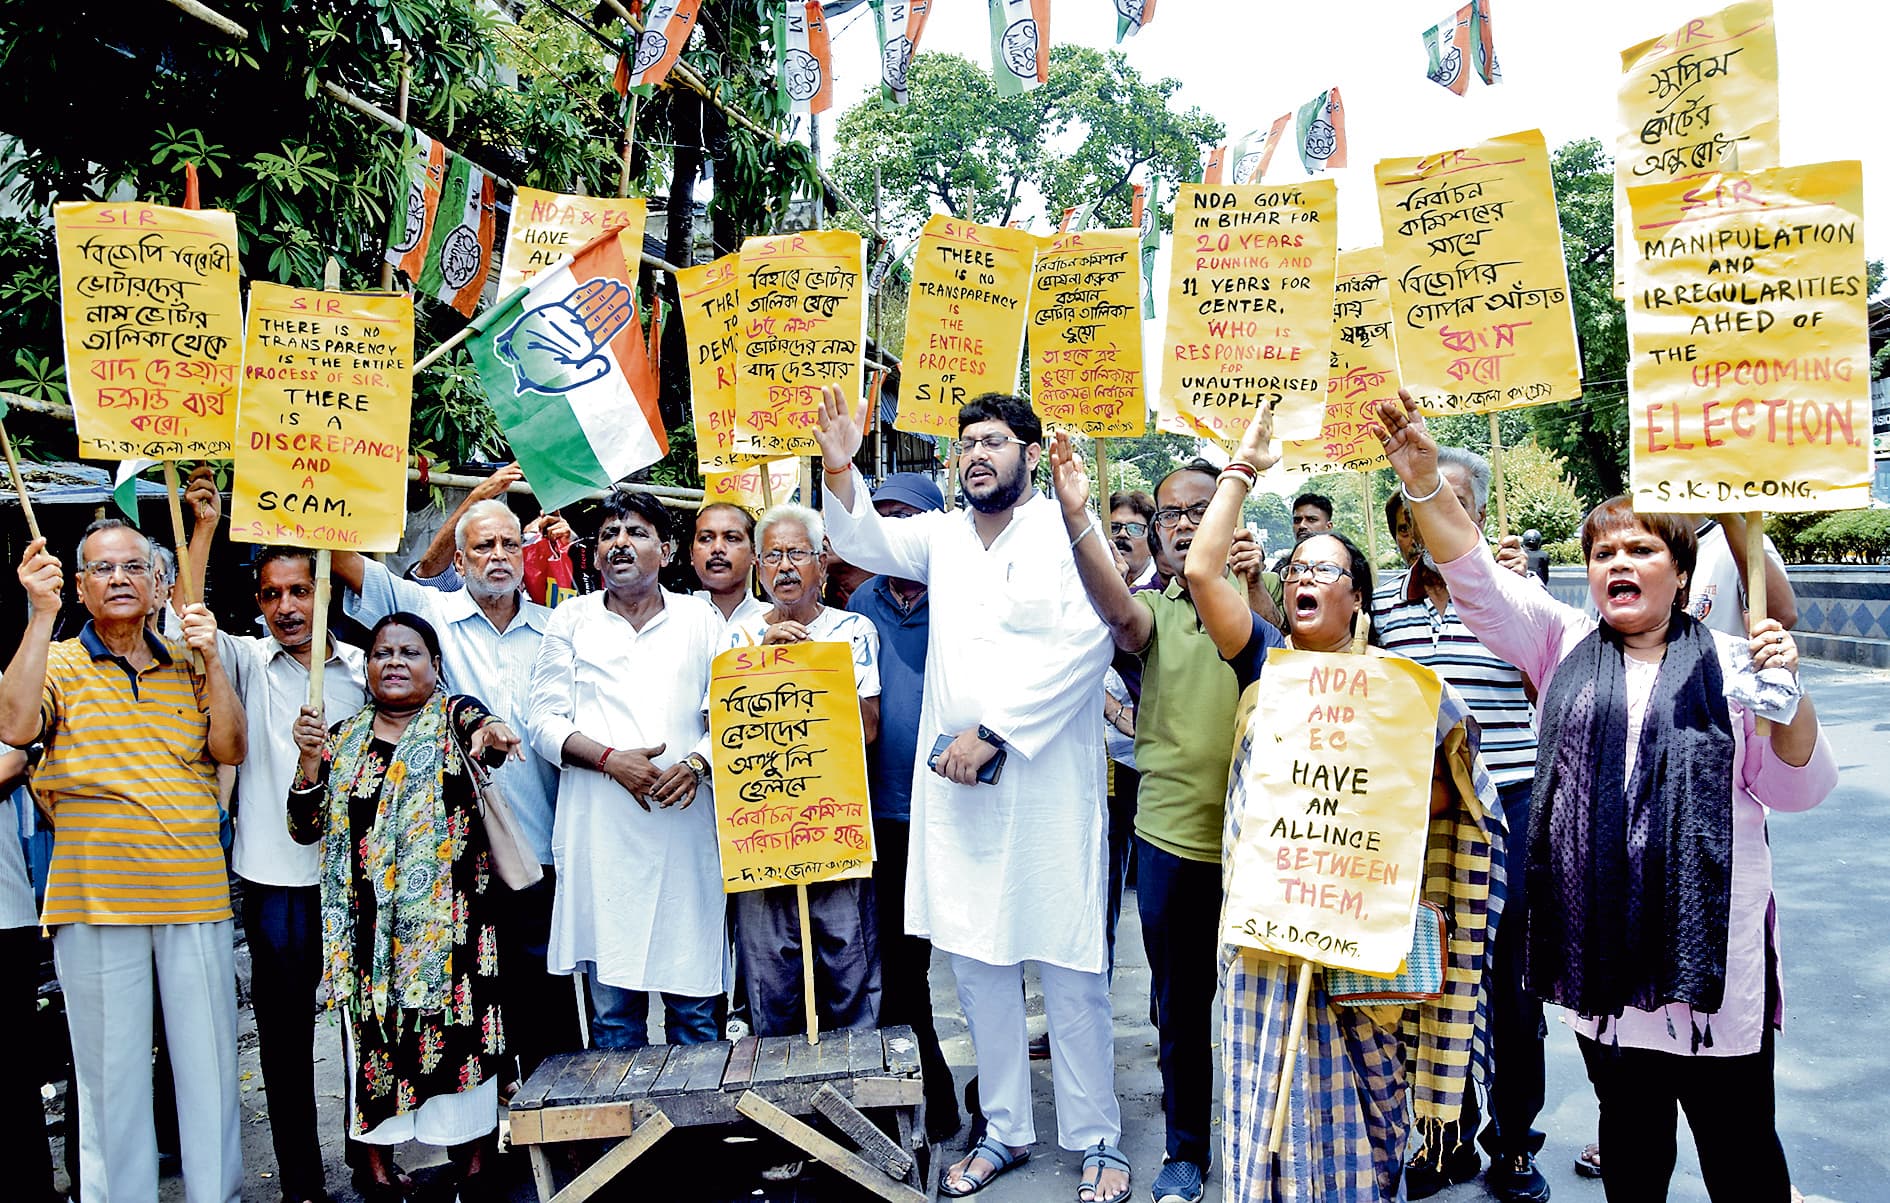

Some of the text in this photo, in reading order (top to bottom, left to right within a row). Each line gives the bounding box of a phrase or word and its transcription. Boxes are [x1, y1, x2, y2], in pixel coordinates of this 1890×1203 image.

[1653, 19, 1713, 53] SIR
[1648, 47, 1744, 114] সুপ্রিম
[1640, 95, 1720, 145] কোর্টের
[1417, 149, 1480, 173] SIR
[1194, 192, 1306, 208] NDA GOVT.
[1396, 178, 1505, 213] নির্বাচন
[1680, 179, 1767, 212] SIR
[96, 210, 157, 225] SIR
[531, 200, 574, 224] NDA
[580, 211, 596, 224] &
[1195, 211, 1320, 228] IN BIHAR FOR
[1397, 200, 1513, 237] কমিশনের
[525, 229, 568, 245] HAVE
[945, 223, 981, 243] SIR
[1053, 235, 1084, 249] SIR
[1197, 233, 1304, 252] 20 YEARS
[1644, 222, 1855, 261] MANIPULATION
[77, 233, 232, 275] বিজেপি বিরোধী
[760, 238, 808, 255] SIR
[937, 246, 995, 268] THERE
[1035, 251, 1128, 273] নির্বাচন কমিশন
[1196, 257, 1312, 271] RUNNING AND
[1707, 256, 1756, 276] AND
[706, 263, 737, 285] SIR
[747, 264, 858, 291] বিহারে ভোটার
[955, 269, 996, 285] IS NO
[1398, 259, 1523, 297] বিজেপির
[77, 272, 200, 307] ভোটারদের
[919, 282, 1018, 310] TRANSPARENCY
[1056, 288, 1107, 305] বর্তমান
[1181, 277, 1310, 297] 11 YEARS FOR
[1643, 276, 1860, 310] IRREGULARITIES
[291, 298, 344, 314] SIR
[747, 290, 849, 317] তালিকা থেকে
[949, 304, 960, 315] IS
[1035, 300, 1135, 325] ভোটার তালিকা
[1407, 294, 1484, 329] গোপন
[1485, 280, 1566, 311] আঁতাত
[86, 302, 219, 328] নাম ভোটার
[940, 319, 963, 331] THE
[1689, 309, 1823, 336] AHED OF
[260, 318, 379, 337] THERE IS NO
[1208, 318, 1291, 339] WHO IS
[82, 328, 232, 360] তালিকা থেকে
[259, 335, 397, 355] TRANSPARENCY
[746, 336, 820, 358] ভোটারদের
[821, 341, 857, 355] নাম
[930, 334, 983, 355] ENTIRE
[1176, 345, 1301, 362] RESPONSIBLE
[1648, 344, 1699, 365] THE
[91, 359, 236, 386] বাদ দেওয়ার
[278, 355, 405, 369] IS THE ENTIRE
[744, 363, 776, 380] বাদ
[781, 361, 855, 383] দেওয়ার
[920, 353, 986, 376] PROCESS
[1220, 363, 1243, 373] FOR
[1446, 354, 1514, 385] করো
[1692, 358, 1851, 388] UPCOMING
[246, 365, 389, 388] PROCESS OF SIR.
[941, 374, 957, 384] OF
[1182, 376, 1318, 392] UNAUTHORISED
[98, 388, 232, 416] চক্রান্ত ব্যর্থ
[284, 389, 369, 411] THERE
[768, 386, 822, 408] চক্রান্ত
[915, 384, 966, 406] SIR
[1094, 384, 1140, 398] নির্বাচন
[279, 411, 343, 429] IS A
[747, 407, 784, 431] ব্যর্থ
[1646, 397, 1863, 454] ELECTION.
[251, 432, 404, 463] DISCREPANCY
[292, 457, 330, 473] AND
[302, 475, 314, 489] A
[258, 491, 352, 517] SCAM.
[735, 648, 795, 670] SIR
[1309, 667, 1368, 698] NDA
[719, 682, 830, 718] বিজেপির
[1308, 705, 1354, 723] AND
[720, 717, 830, 750] নেতাদের
[1310, 728, 1347, 750] EC
[1292, 760, 1368, 795] HAVE
[726, 797, 863, 828] নির্বাচন কমিশন
[1306, 798, 1339, 816] AN
[731, 820, 829, 854] পরিচালিত
[1270, 817, 1381, 853] ALLINCE
[1277, 845, 1398, 886] BETWEEN
[1279, 878, 1371, 923] THEM.
